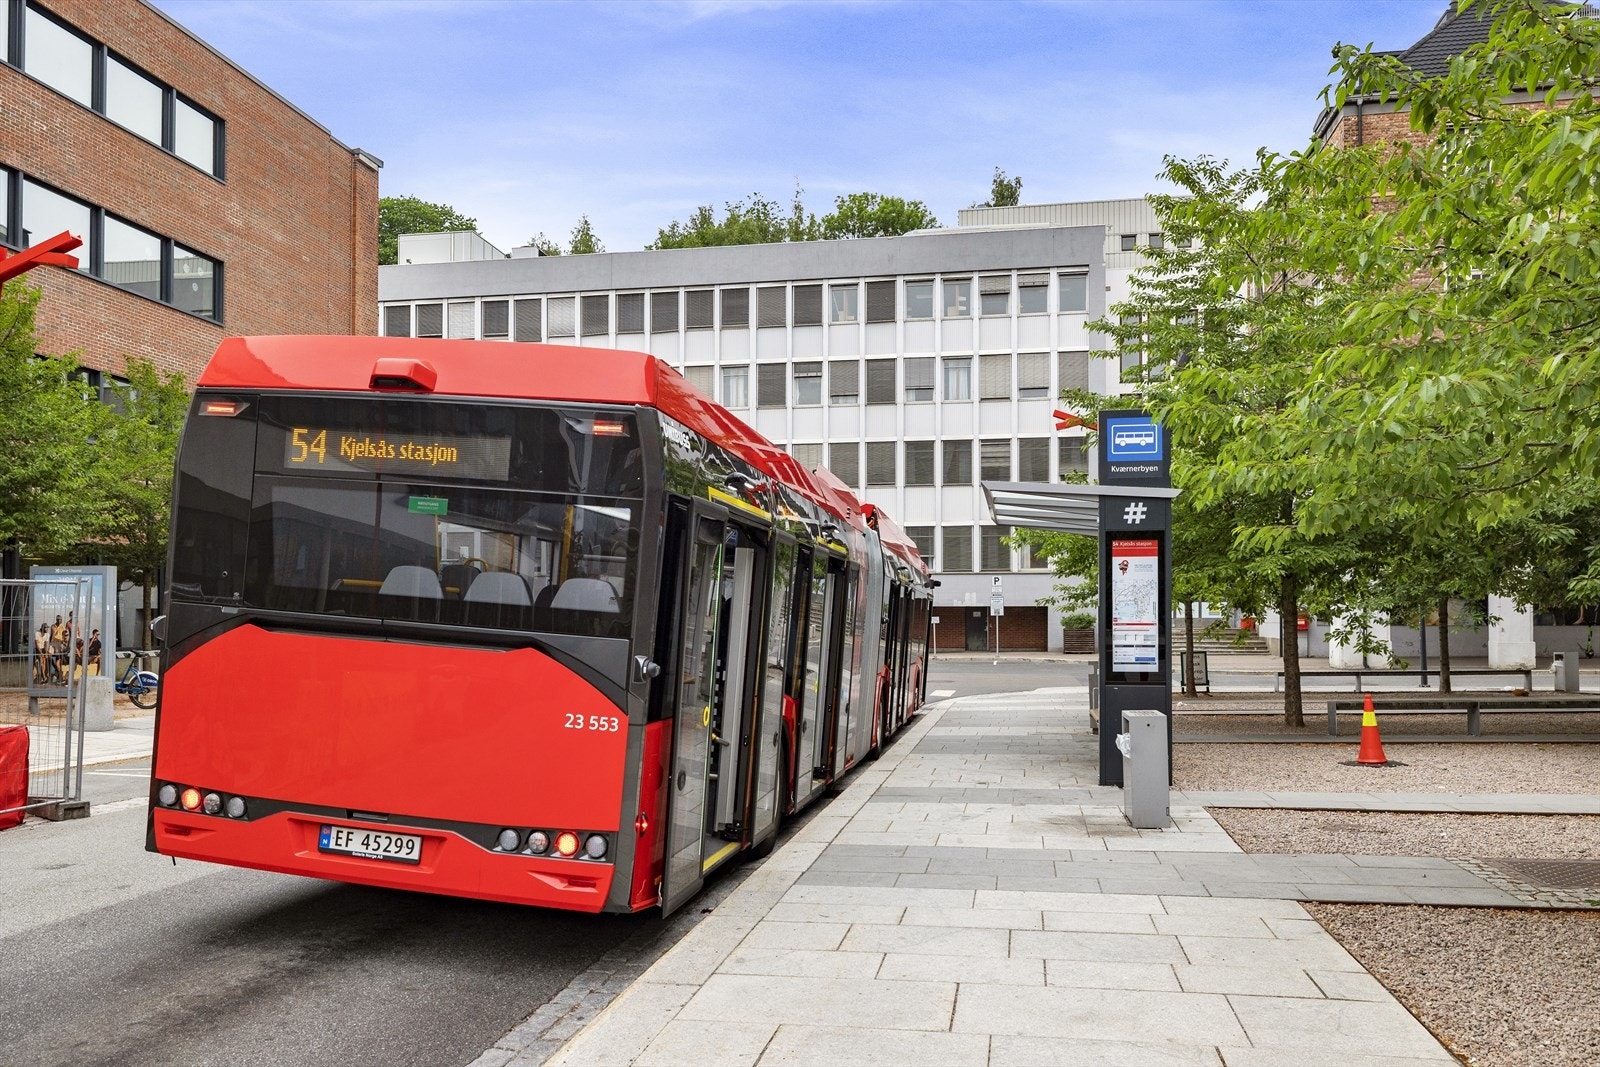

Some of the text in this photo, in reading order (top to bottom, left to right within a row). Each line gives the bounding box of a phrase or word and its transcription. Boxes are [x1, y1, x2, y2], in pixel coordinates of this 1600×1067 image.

[291, 428, 457, 466] 54 Kjelsås stasjon
[1111, 465, 1159, 473] Kværnerbyen
[993, 576, 1000, 585] P
[41, 594, 58, 604] Mix
[564, 713, 619, 732] 23 553
[335, 829, 415, 856] EF 45299
